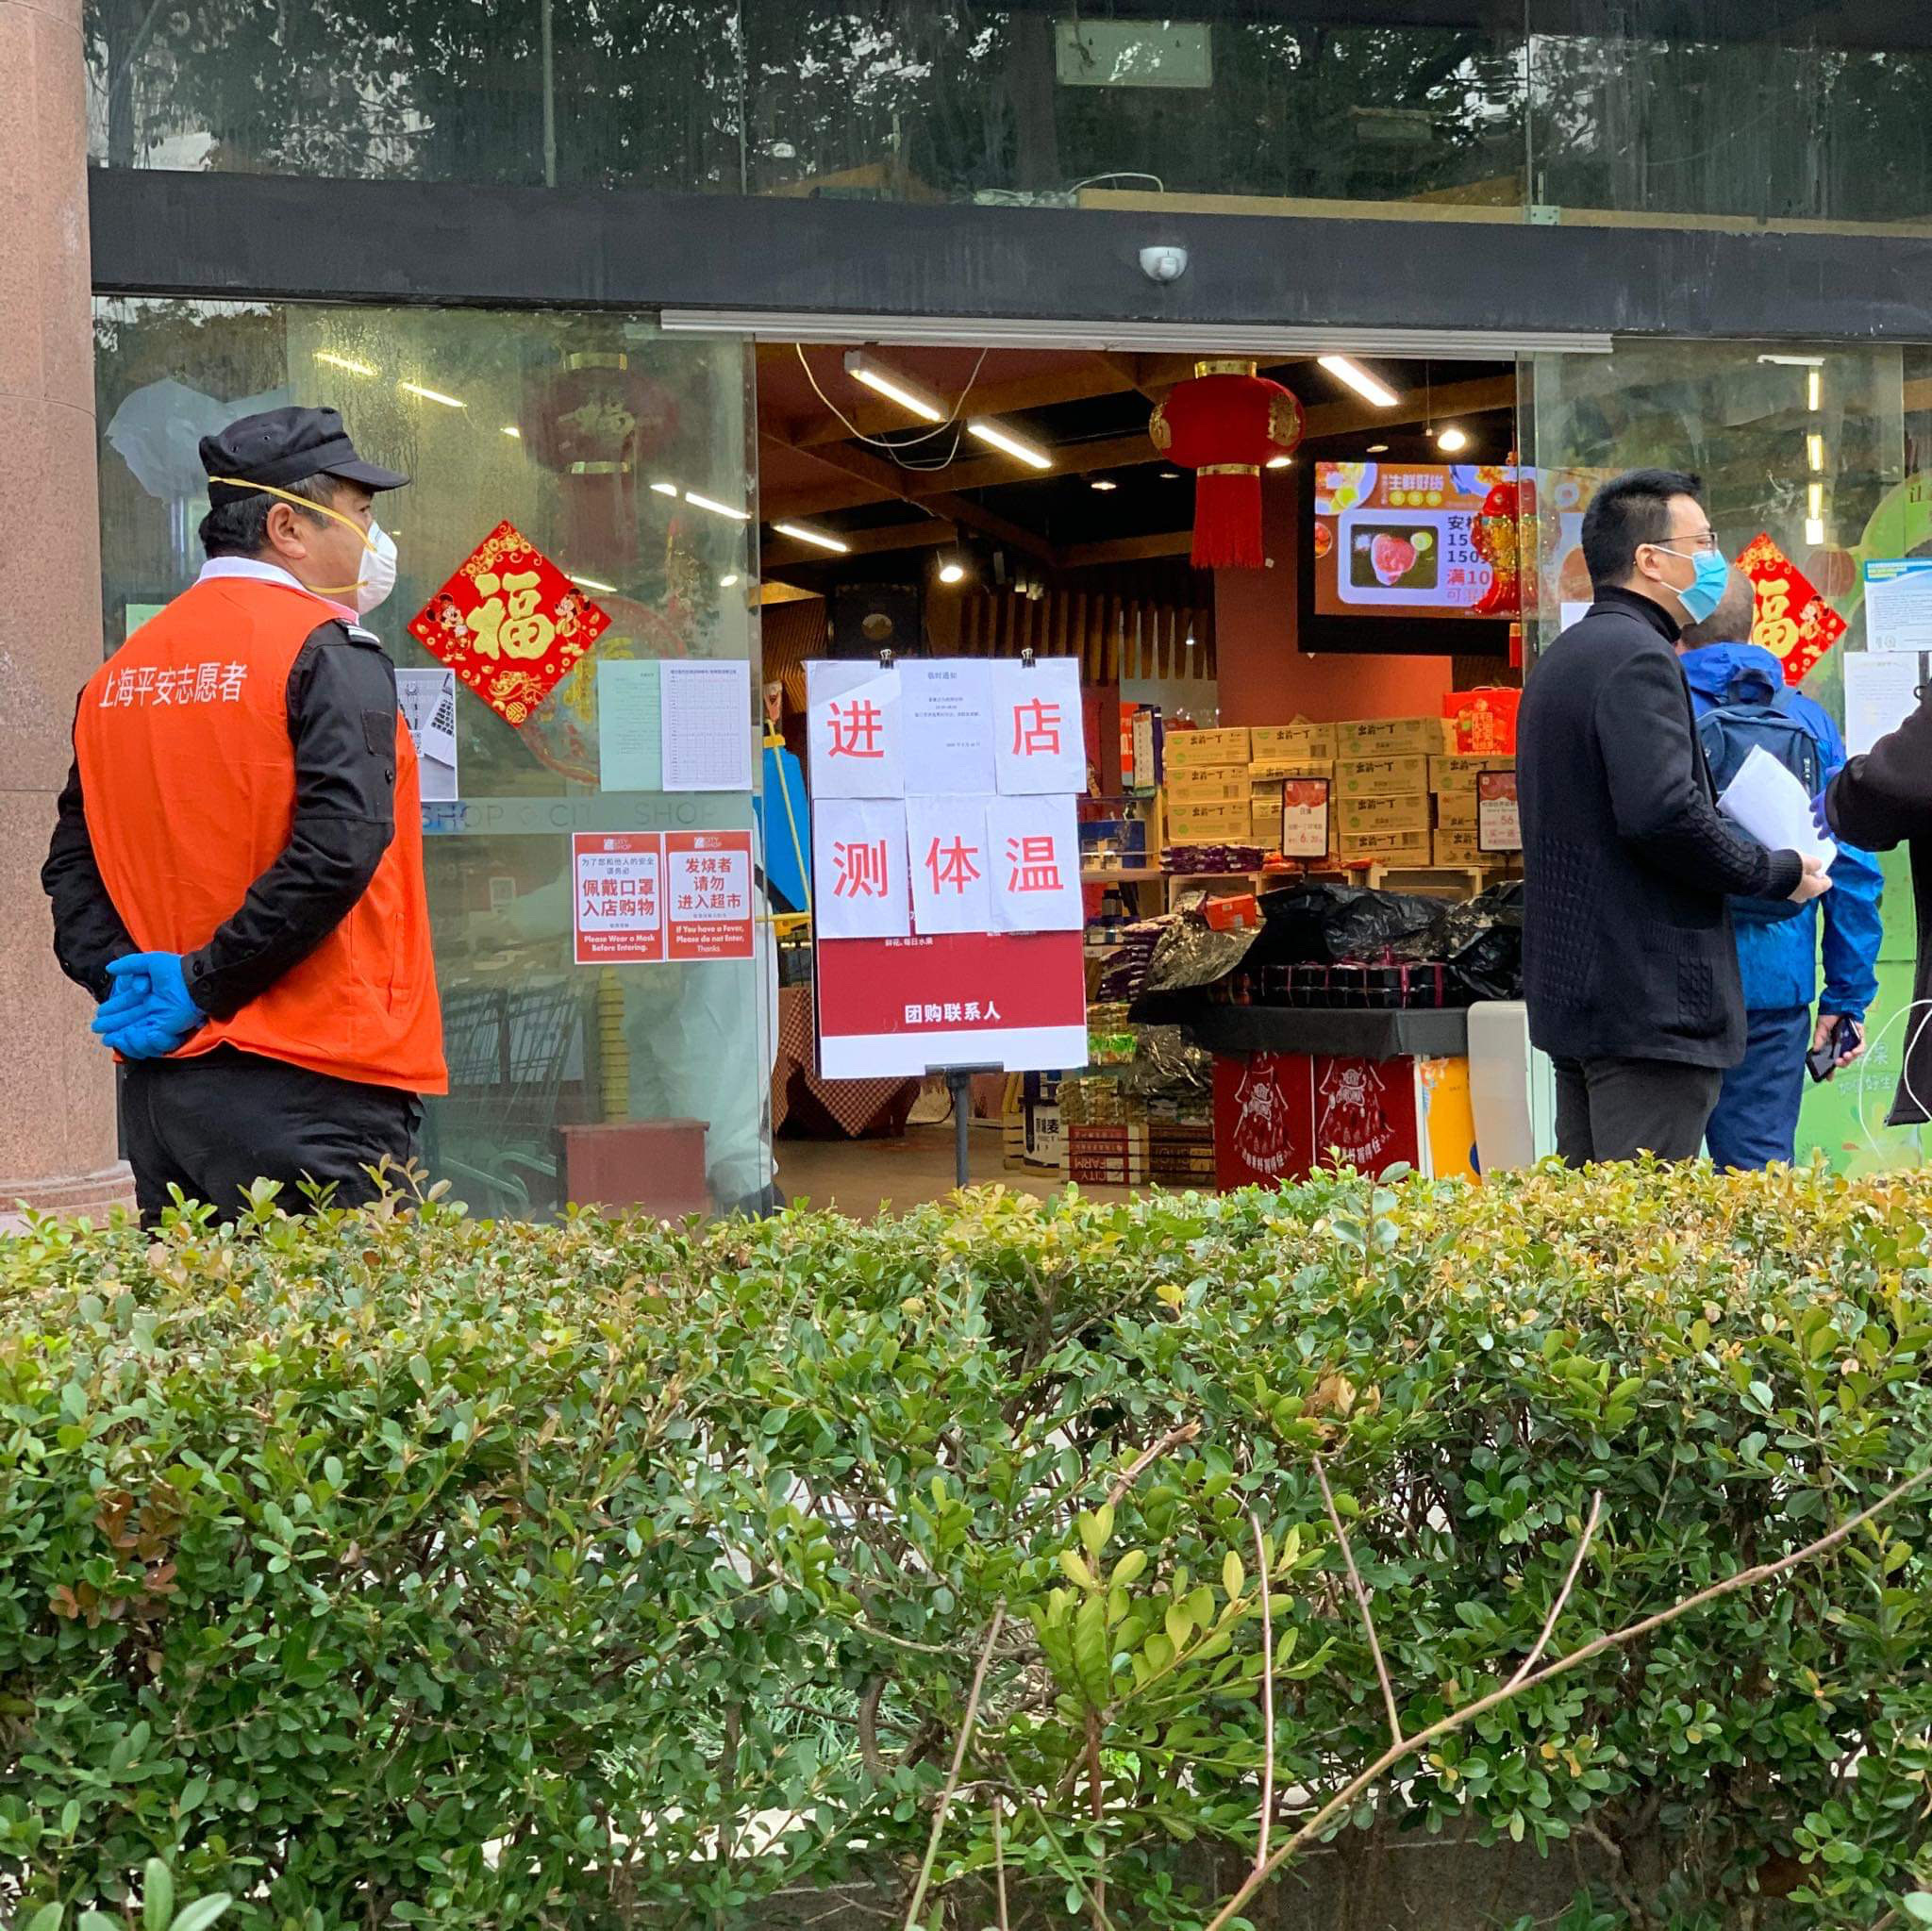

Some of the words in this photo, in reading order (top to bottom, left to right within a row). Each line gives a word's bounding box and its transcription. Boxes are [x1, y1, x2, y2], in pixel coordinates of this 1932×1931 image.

[466, 571, 556, 660] 福
[99, 660, 247, 707] 上海平安志愿者
[826, 700, 884, 758] 进
[1012, 698, 1061, 756] 店
[1450, 817, 1477, 826] 出前一
[582, 857, 655, 866] 为了您和他人的安全
[686, 857, 732, 874] 发烧者
[833, 836, 1064, 899] 测体温
[583, 878, 655, 897] 佩戴口罩
[694, 875, 724, 891] 请勿
[583, 899, 655, 917] 入店购物
[677, 893, 741, 909] 进入超市
[697, 924, 716, 933] have
[636, 933, 656, 941] Mask
[675, 935, 699, 943] Please
[591, 943, 616, 952] Before
[616, 943, 648, 952] Entering.
[905, 1000, 1002, 1024] 团购联系人
